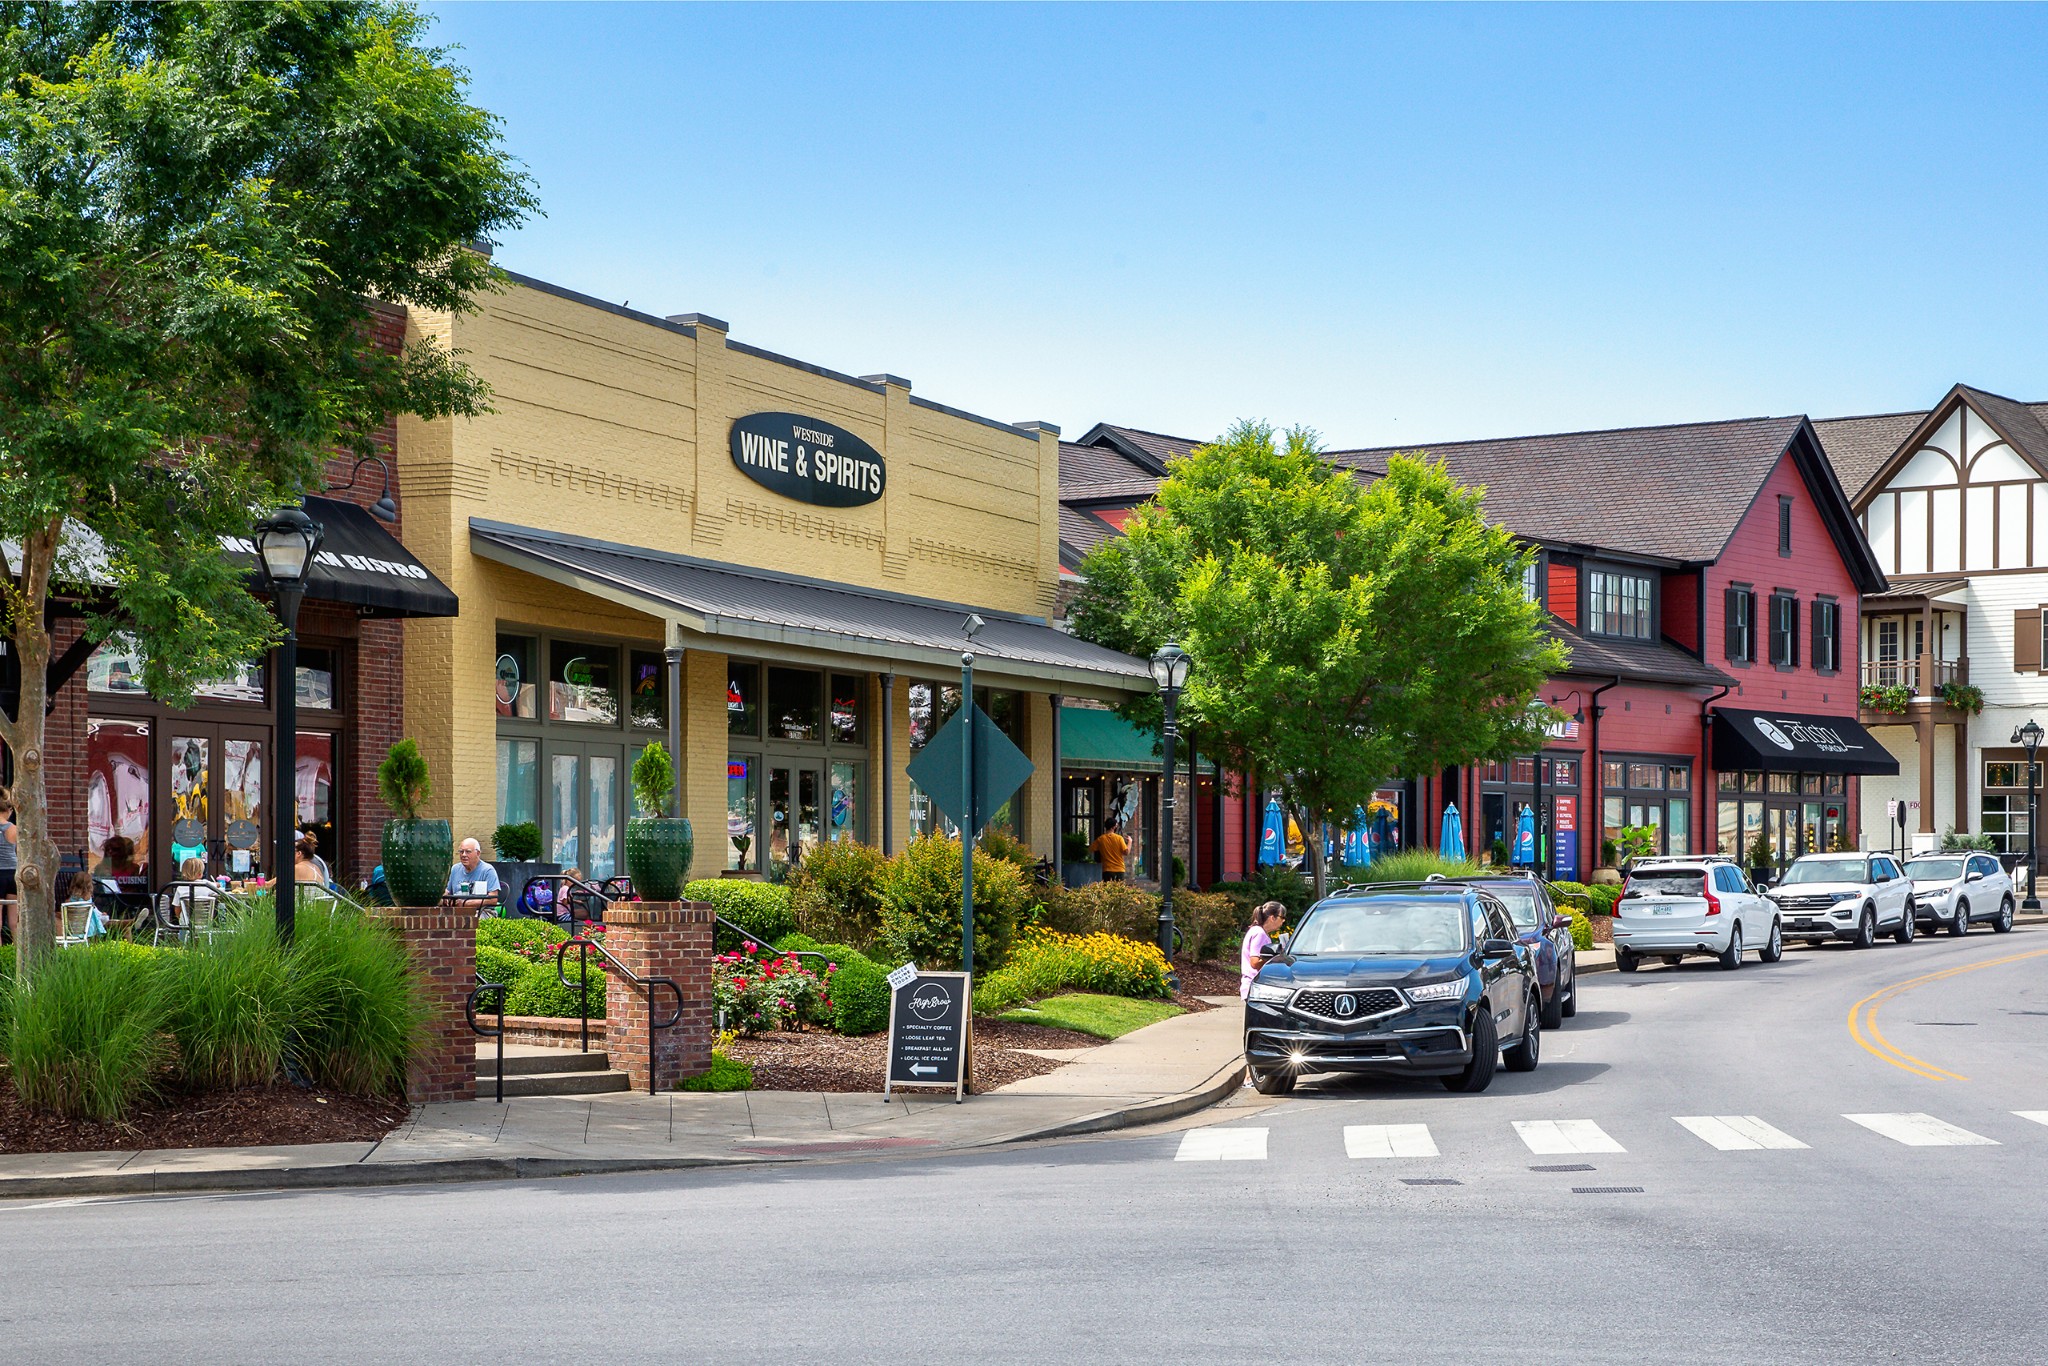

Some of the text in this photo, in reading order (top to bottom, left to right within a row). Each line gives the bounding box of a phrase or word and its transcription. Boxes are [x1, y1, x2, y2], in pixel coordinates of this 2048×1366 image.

[792, 425, 834, 448] WESTSIDE
[740, 430, 881, 495] WINE & SPIRITS
[341, 554, 428, 580] BISTRO
[118, 876, 148, 885] CUISINE
